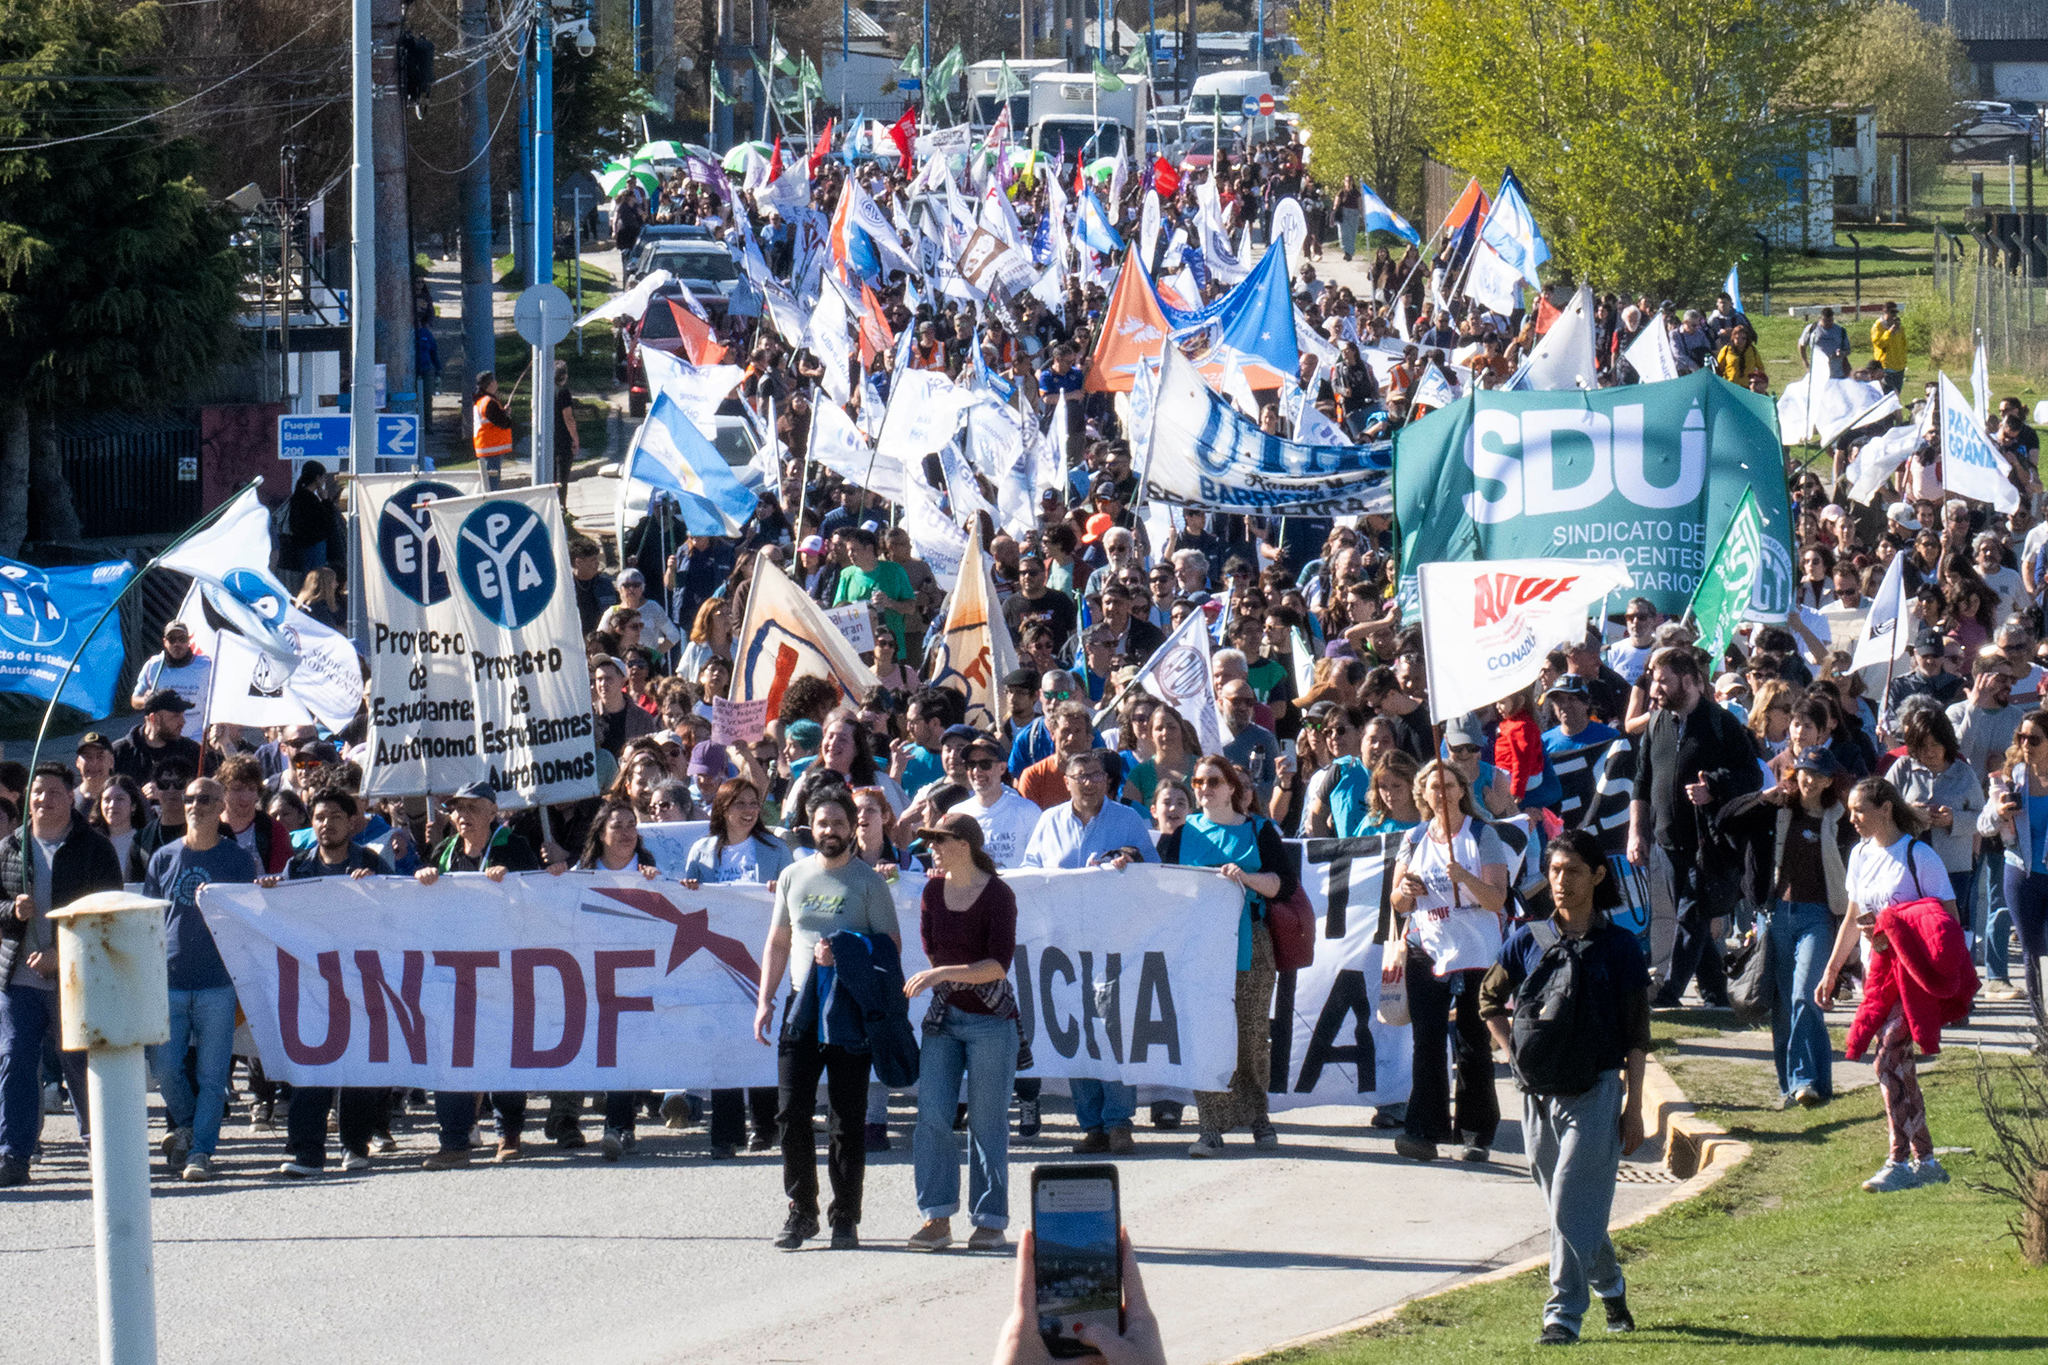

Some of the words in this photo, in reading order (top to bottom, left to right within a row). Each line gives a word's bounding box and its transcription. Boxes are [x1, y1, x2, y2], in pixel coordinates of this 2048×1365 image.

[283, 421, 320, 432] Fuegia
[283, 431, 323, 441] Basket
[284, 447, 304, 456] 200
[336, 446, 350, 456] 10
[1462, 396, 1707, 524] SDU
[1553, 520, 1673, 547] SINDICATO
[1679, 521, 1706, 545] DE
[375, 623, 466, 655] Proyecto
[17, 651, 32, 661] de
[473, 647, 562, 682] Proyecto
[409, 661, 428, 691] de
[511, 685, 530, 715] de
[375, 729, 477, 767] Autónomo
[482, 712, 593, 755] Estudiantes
[276, 946, 656, 1069] UNTDF
[1013, 944, 1182, 1066] UCHA
